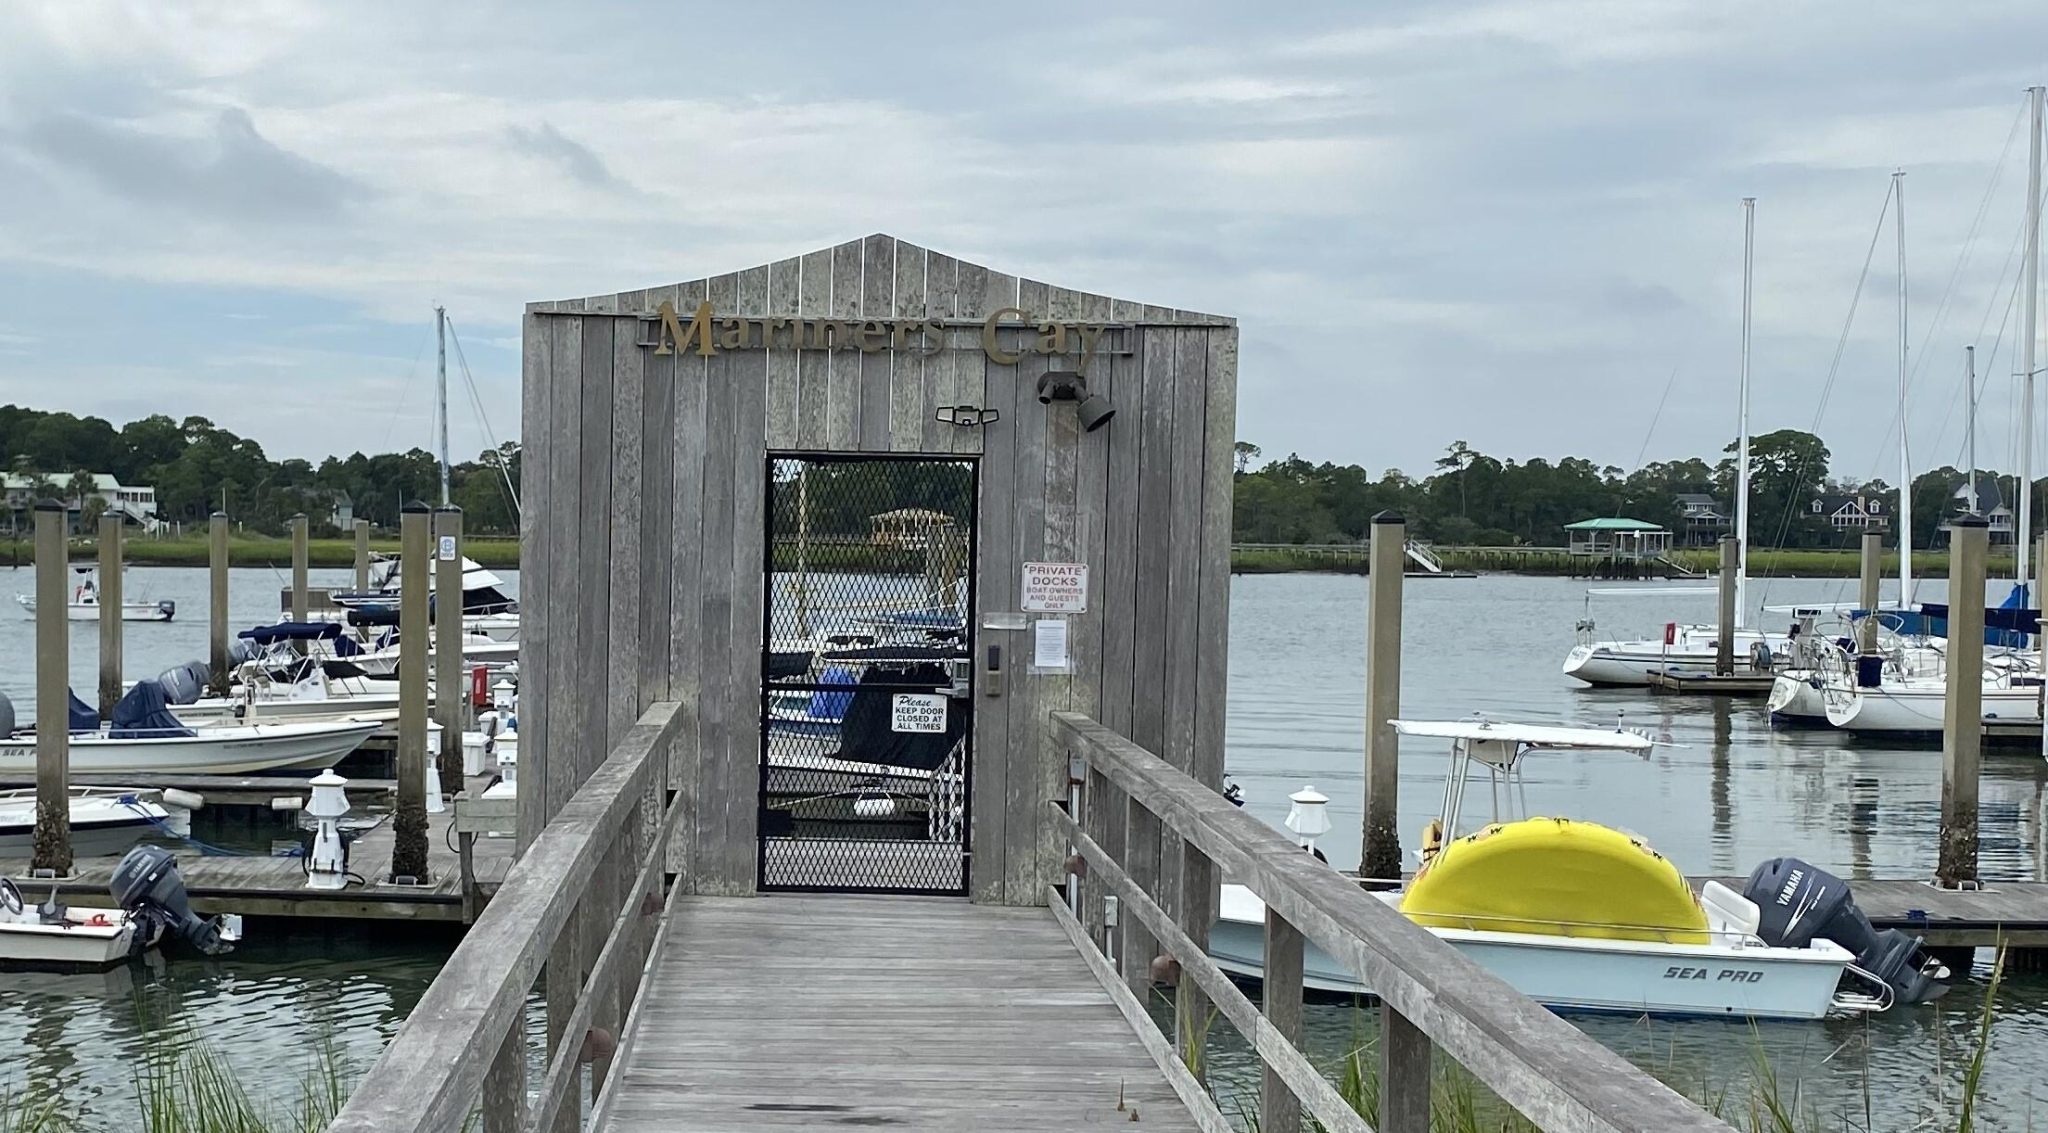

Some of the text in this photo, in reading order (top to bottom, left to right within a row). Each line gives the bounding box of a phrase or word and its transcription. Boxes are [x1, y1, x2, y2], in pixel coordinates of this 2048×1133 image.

[654, 301, 1106, 376] Mariners Cay
[1029, 566, 1082, 576] PRIVATE
[1033, 577, 1078, 586] DOCKS
[1027, 586, 1047, 594] BOAT
[899, 695, 931, 706] Please
[920, 707, 944, 715] DOOR
[2, 748, 25, 757] SEA
[1776, 869, 1805, 906] YAMAHA
[1663, 967, 1764, 983] SEA PRO
